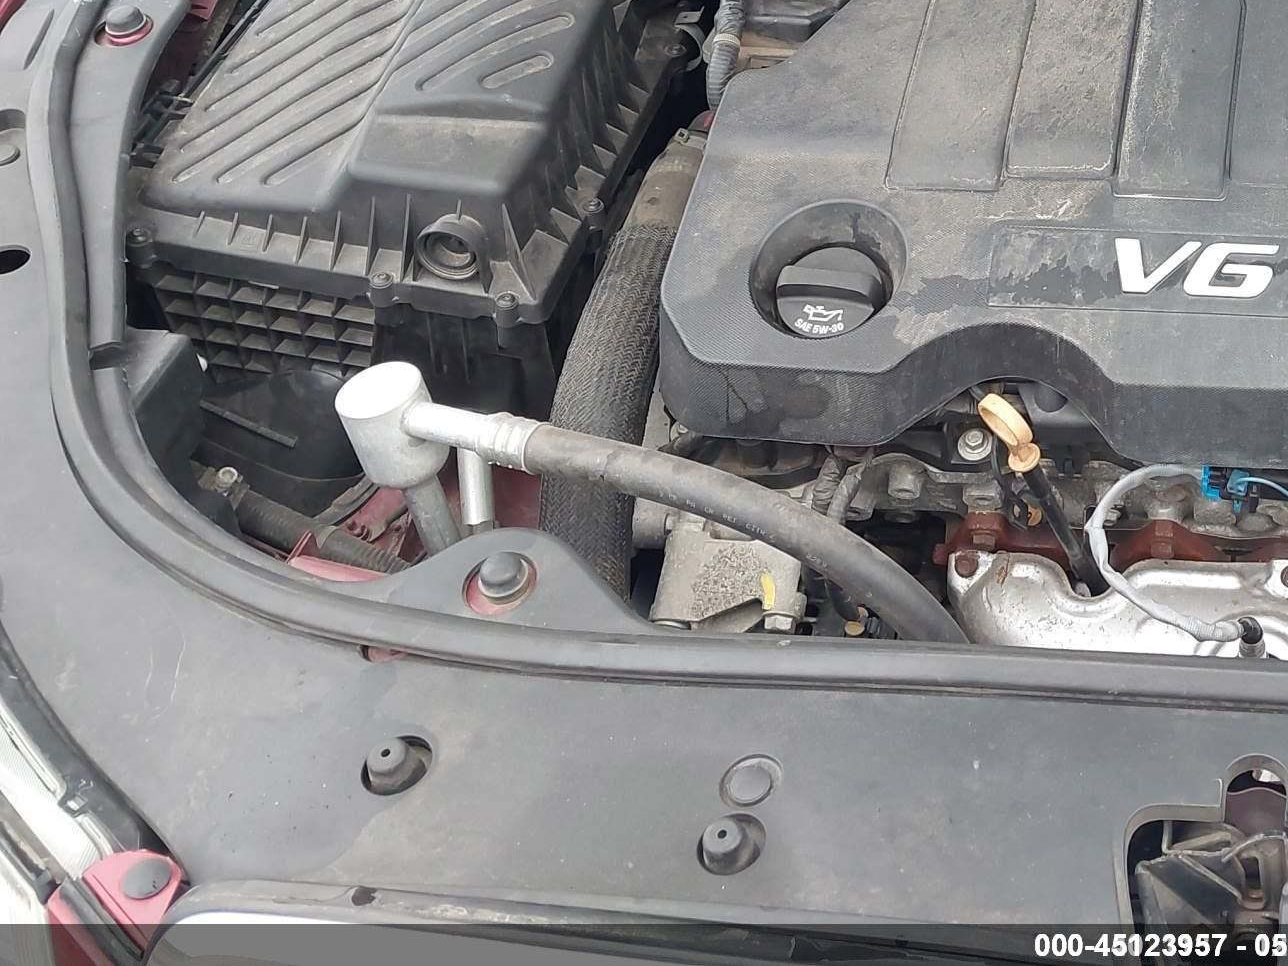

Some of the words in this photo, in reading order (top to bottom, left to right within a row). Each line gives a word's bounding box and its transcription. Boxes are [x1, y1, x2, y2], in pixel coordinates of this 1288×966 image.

[1115, 237, 1279, 298] V6
[794, 319, 811, 332] SAE
[812, 322, 844, 334] 5W-30
